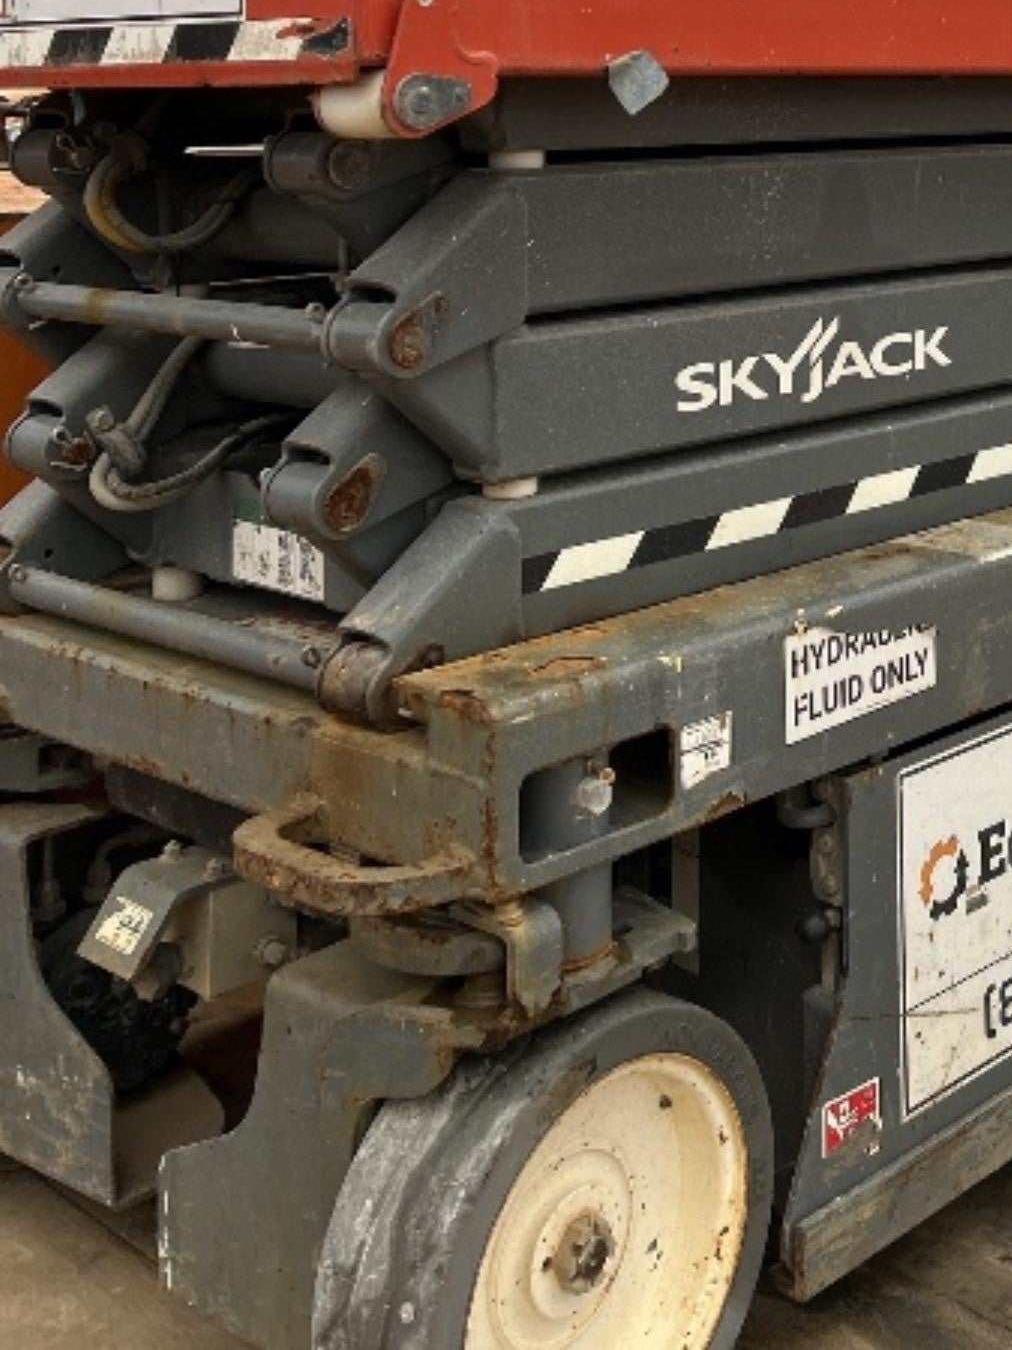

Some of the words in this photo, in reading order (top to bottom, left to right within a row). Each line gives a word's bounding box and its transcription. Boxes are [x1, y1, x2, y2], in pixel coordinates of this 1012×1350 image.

[674, 314, 952, 412] SKYJACK
[794, 673, 864, 727] FLUID
[871, 647, 929, 694] ONLY
